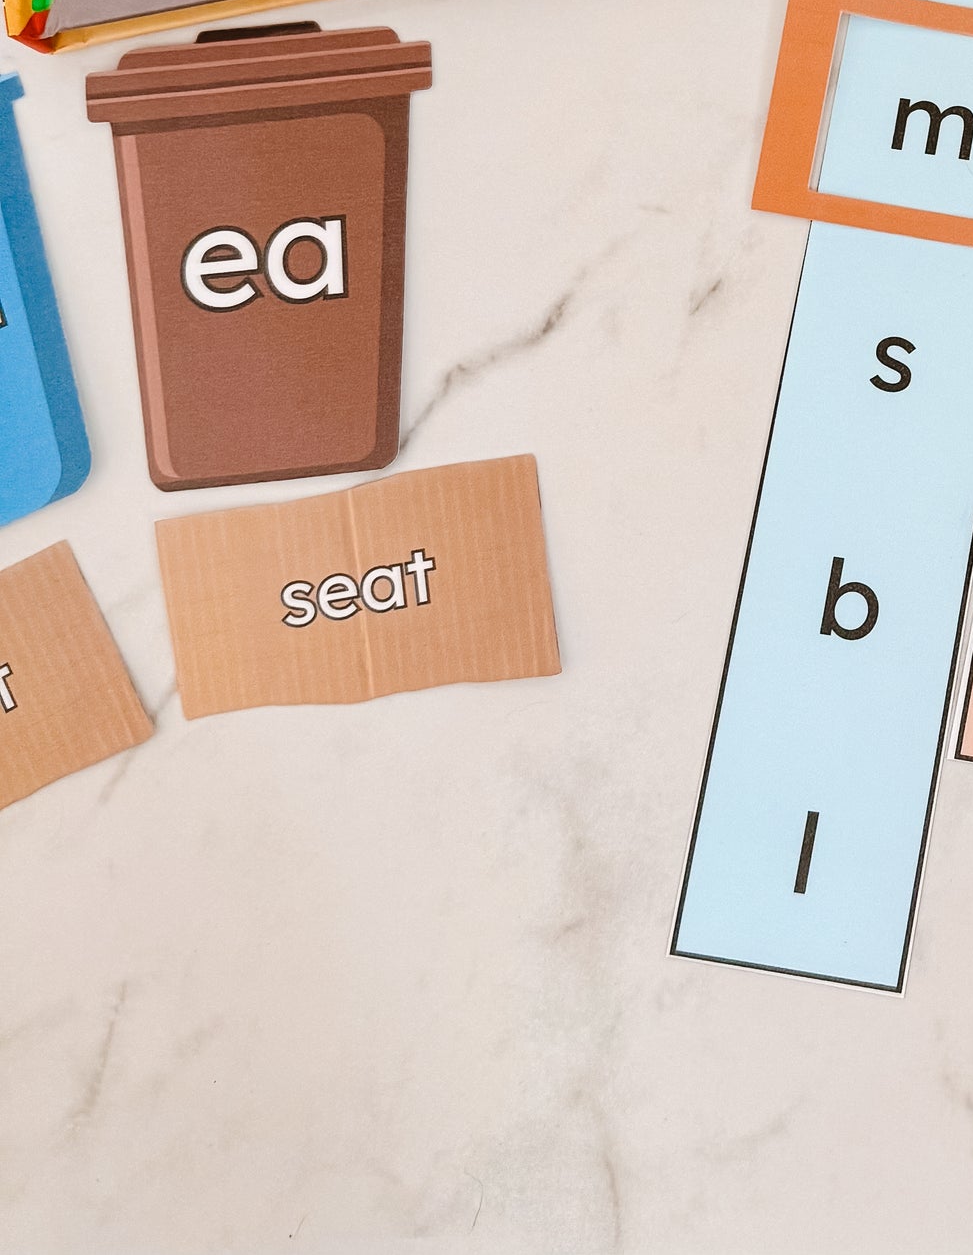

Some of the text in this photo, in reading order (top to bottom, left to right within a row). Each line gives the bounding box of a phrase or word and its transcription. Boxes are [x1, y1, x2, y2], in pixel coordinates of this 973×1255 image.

[180, 214, 350, 314] ea
[868, 335, 918, 394] s
[281, 549, 437, 628] seat
[818, 555, 880, 642] b
[792, 809, 821, 896] l
